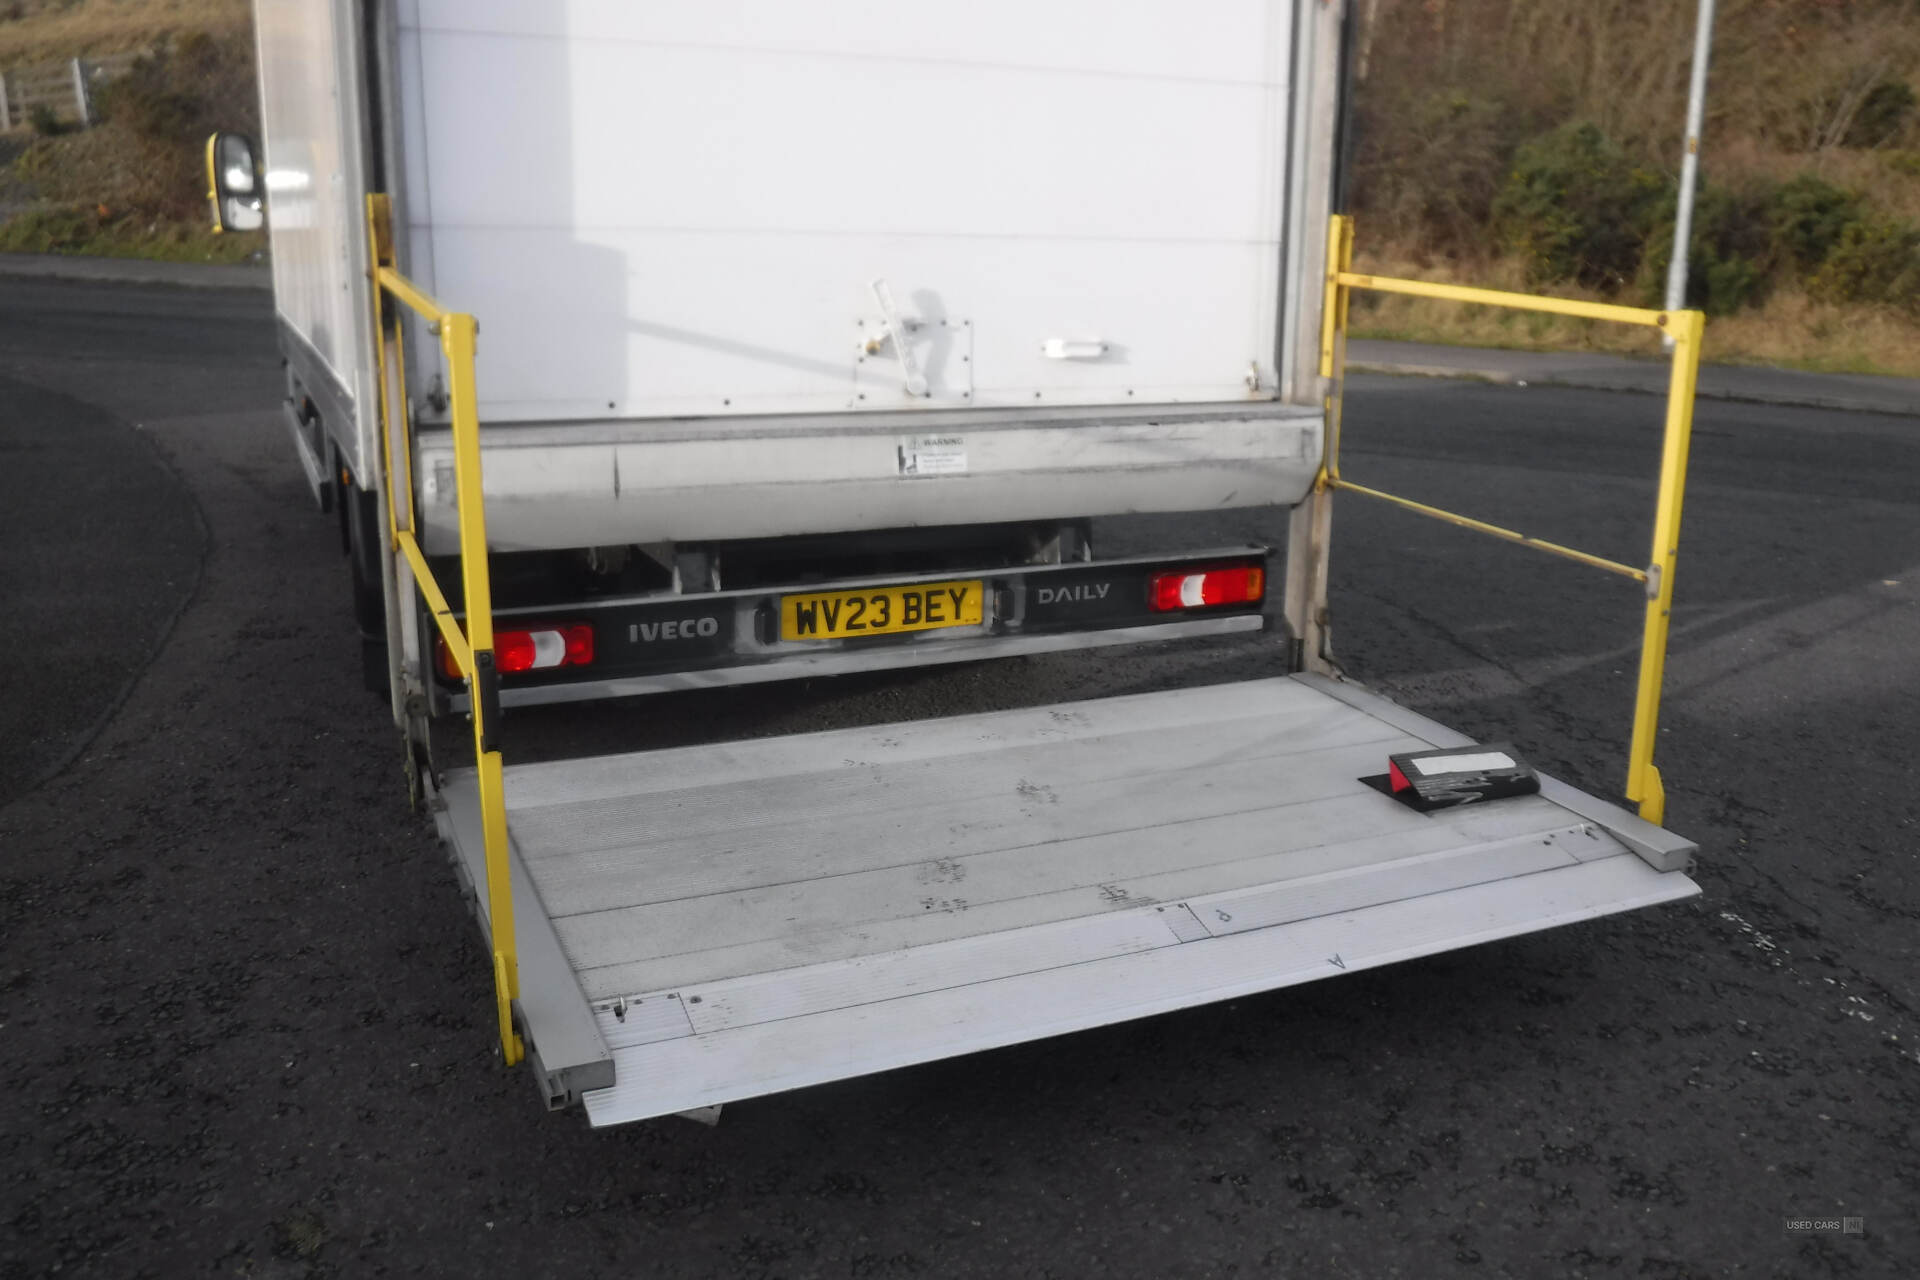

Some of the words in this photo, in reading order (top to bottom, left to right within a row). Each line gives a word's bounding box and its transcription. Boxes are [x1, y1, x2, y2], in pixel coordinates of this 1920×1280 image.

[1038, 583, 1111, 605] DAILY
[796, 594, 891, 635] WV23
[902, 586, 968, 625] BEY
[629, 617, 719, 643] IVECO
